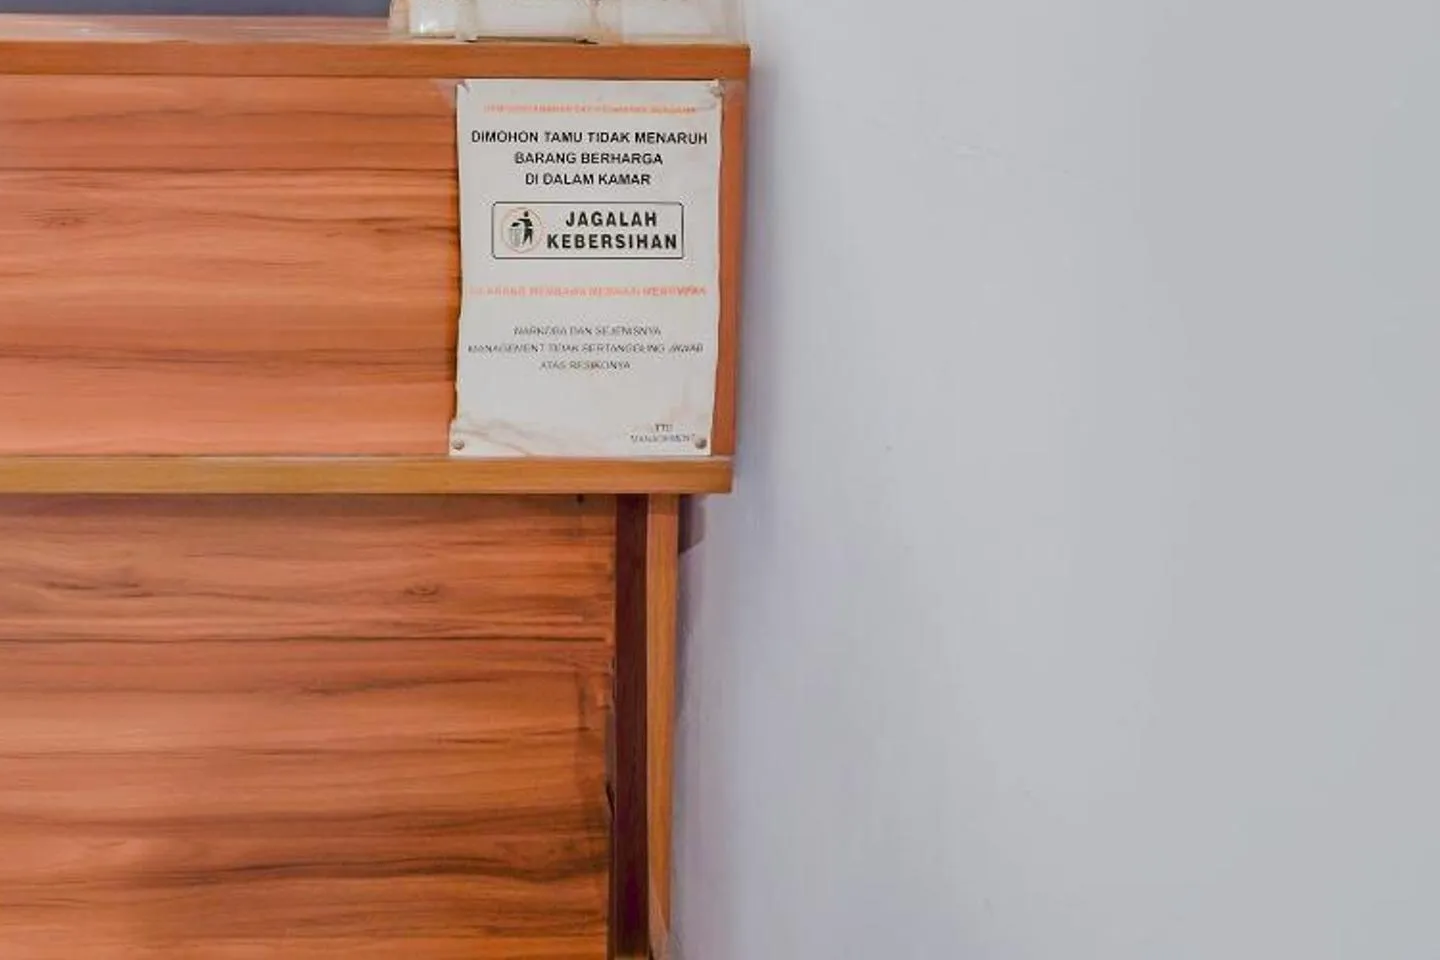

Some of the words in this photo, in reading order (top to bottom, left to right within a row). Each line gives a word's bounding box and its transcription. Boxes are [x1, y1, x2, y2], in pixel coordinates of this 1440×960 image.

[471, 130, 539, 144] DIMOHON
[544, 131, 583, 144] TAMU
[587, 132, 631, 144] TIDAK
[635, 132, 708, 145] MENARUH
[514, 152, 577, 165] BARANG
[580, 152, 664, 166] BERHARGA
[525, 173, 539, 186] DI
[543, 173, 595, 186] DALAM
[598, 173, 652, 186] KAMAR
[565, 211, 657, 227] JAGALAH
[547, 234, 677, 249] KEBERSIHAN
